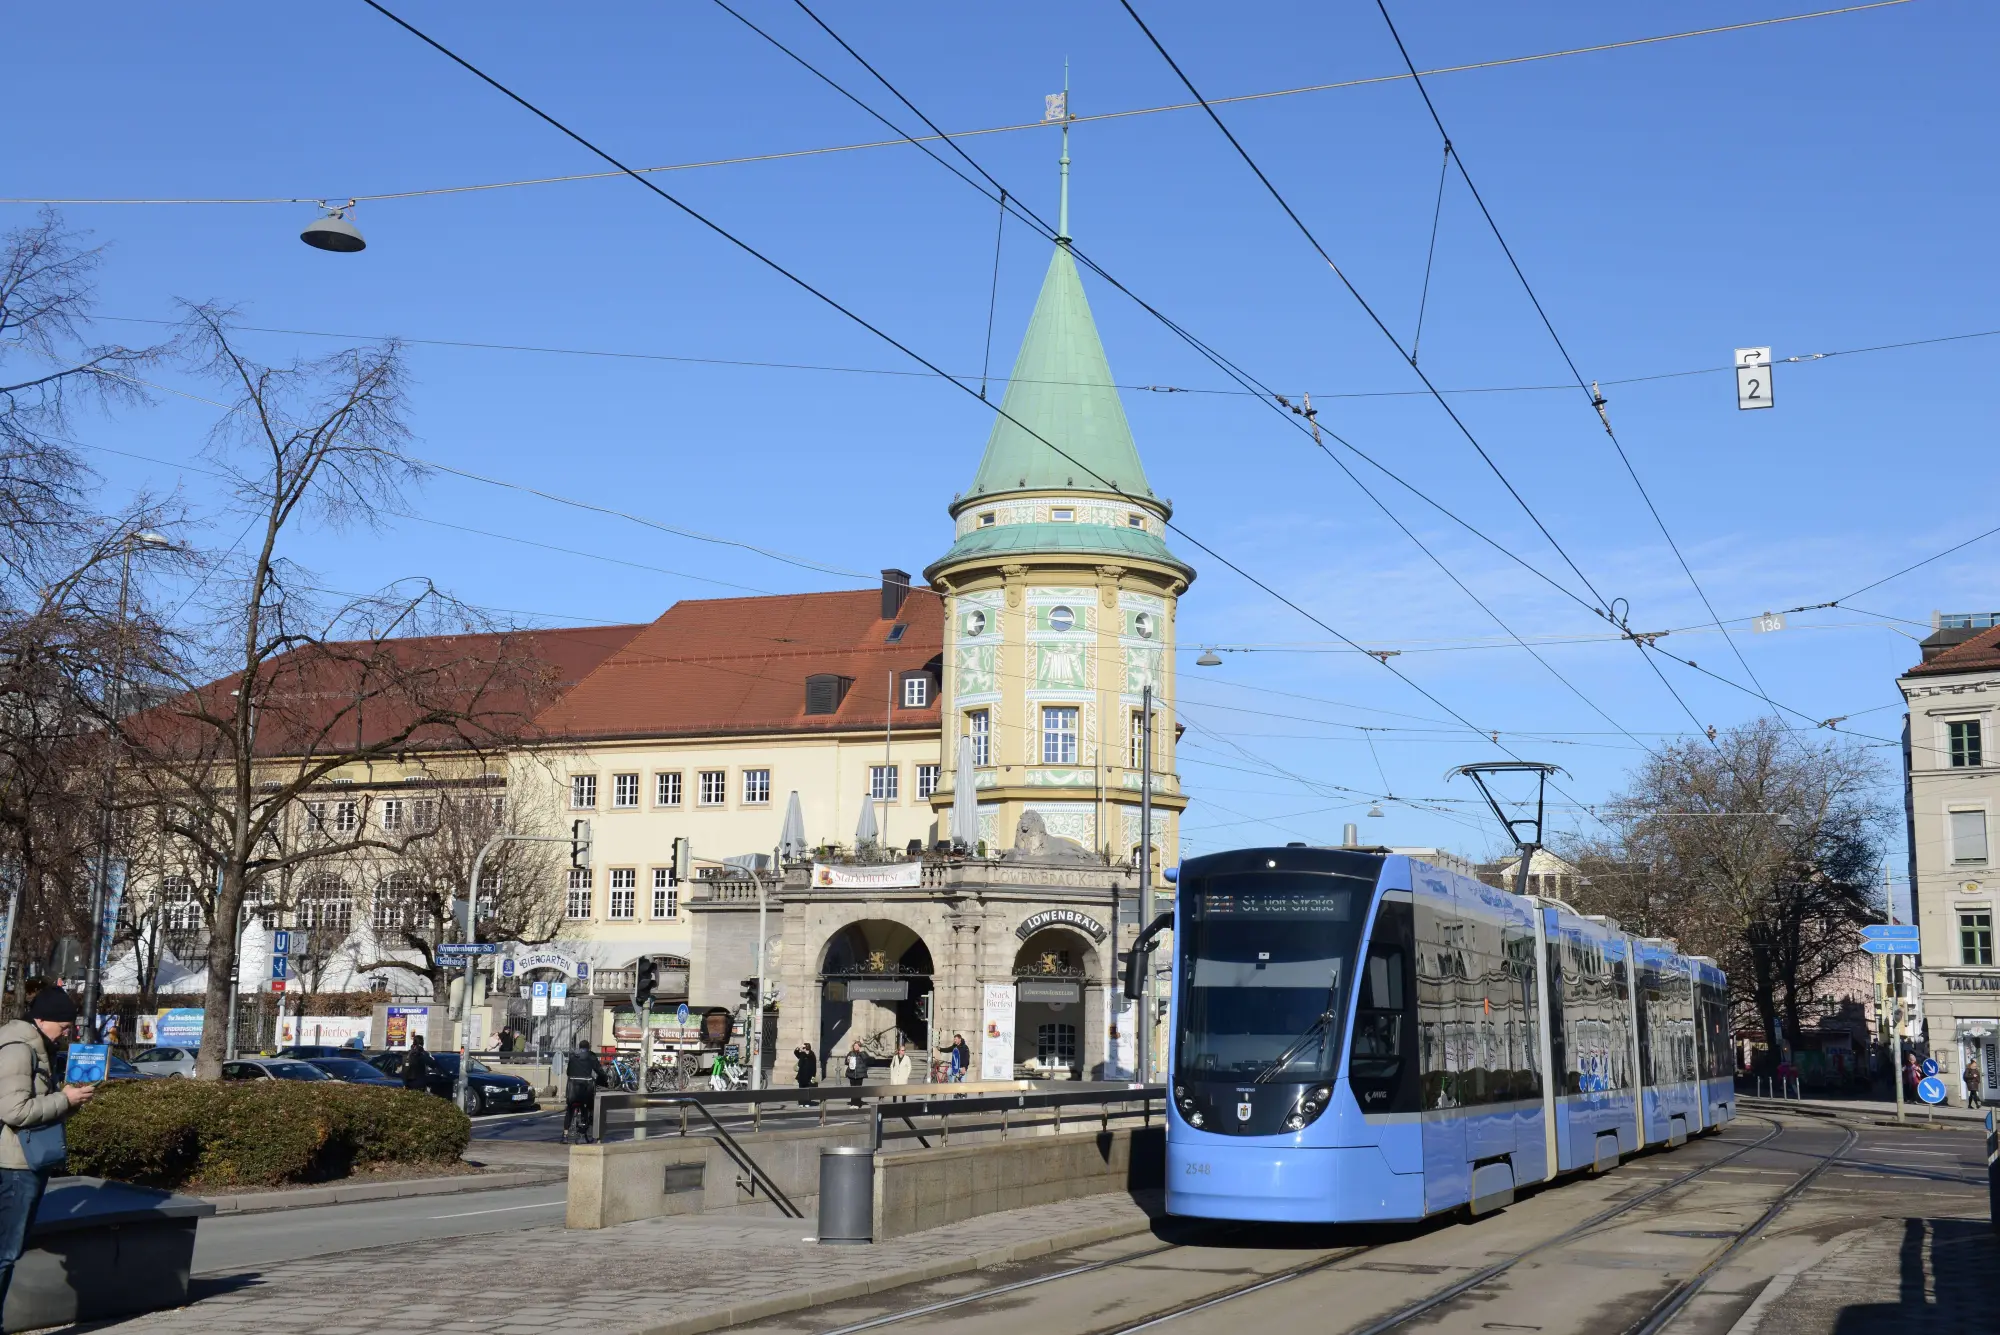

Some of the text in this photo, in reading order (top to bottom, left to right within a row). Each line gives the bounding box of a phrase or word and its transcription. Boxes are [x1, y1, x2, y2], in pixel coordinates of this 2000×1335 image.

[1748, 379, 1760, 399] 2
[1760, 618, 1780, 632] 136
[1027, 910, 1099, 932] LÖWENBRÄU
[276, 934, 286, 950] U
[520, 954, 571, 971] BIERGARTEN
[535, 984, 543, 995] P
[554, 985, 563, 996] P
[990, 990, 1010, 999] Stark
[658, 1029, 699, 1039] Biergrten
[1371, 1091, 1387, 1099] MVG
[1186, 1163, 1211, 1175] 2548
